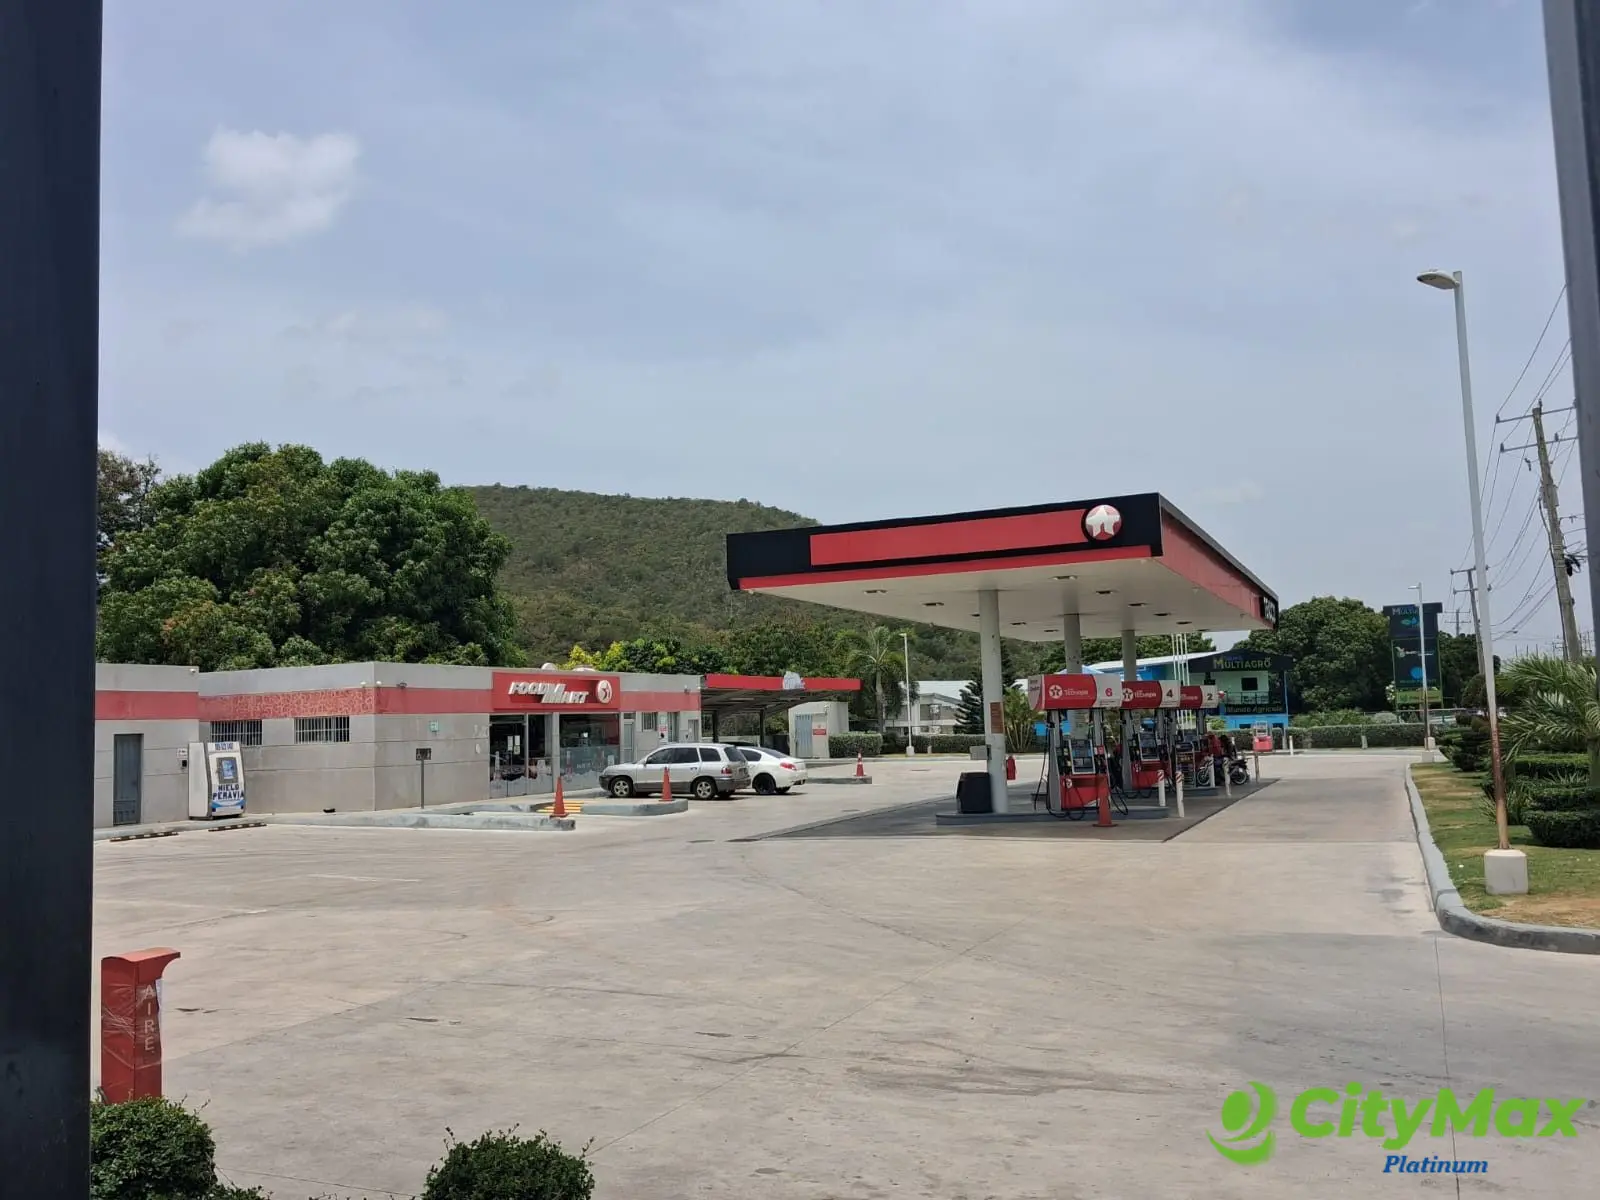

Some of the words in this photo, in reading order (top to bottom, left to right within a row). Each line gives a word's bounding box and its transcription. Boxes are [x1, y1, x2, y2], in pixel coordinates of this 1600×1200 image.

[1213, 656, 1271, 669] MULTIAGRO
[508, 682, 548, 695] FOOD
[1105, 688, 1112, 697] 6
[1166, 690, 1173, 698] 4
[213, 790, 245, 800] PERAVIA
[144, 985, 156, 1051] AIRE
